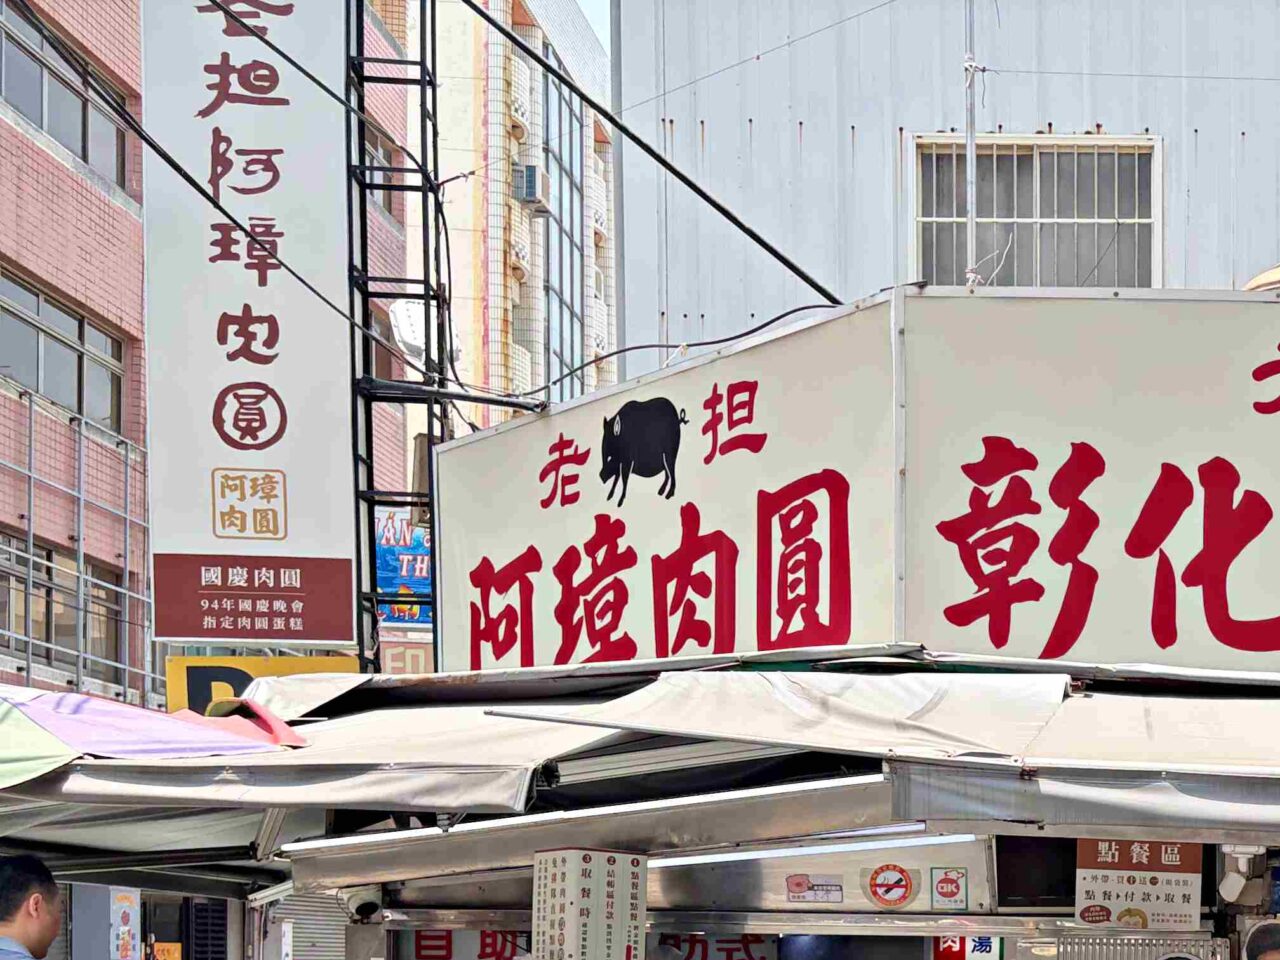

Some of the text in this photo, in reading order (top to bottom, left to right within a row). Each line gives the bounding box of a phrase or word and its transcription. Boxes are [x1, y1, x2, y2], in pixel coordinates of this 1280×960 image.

[201, 566, 301, 588] 國慶肉圓
[469, 468, 852, 671] 阿璋肉圓
[201, 598, 304, 613] 94年國慶晚會
[203, 616, 304, 630] 指定肉圓蛋糕
[1097, 841, 1182, 864] 點餐區
